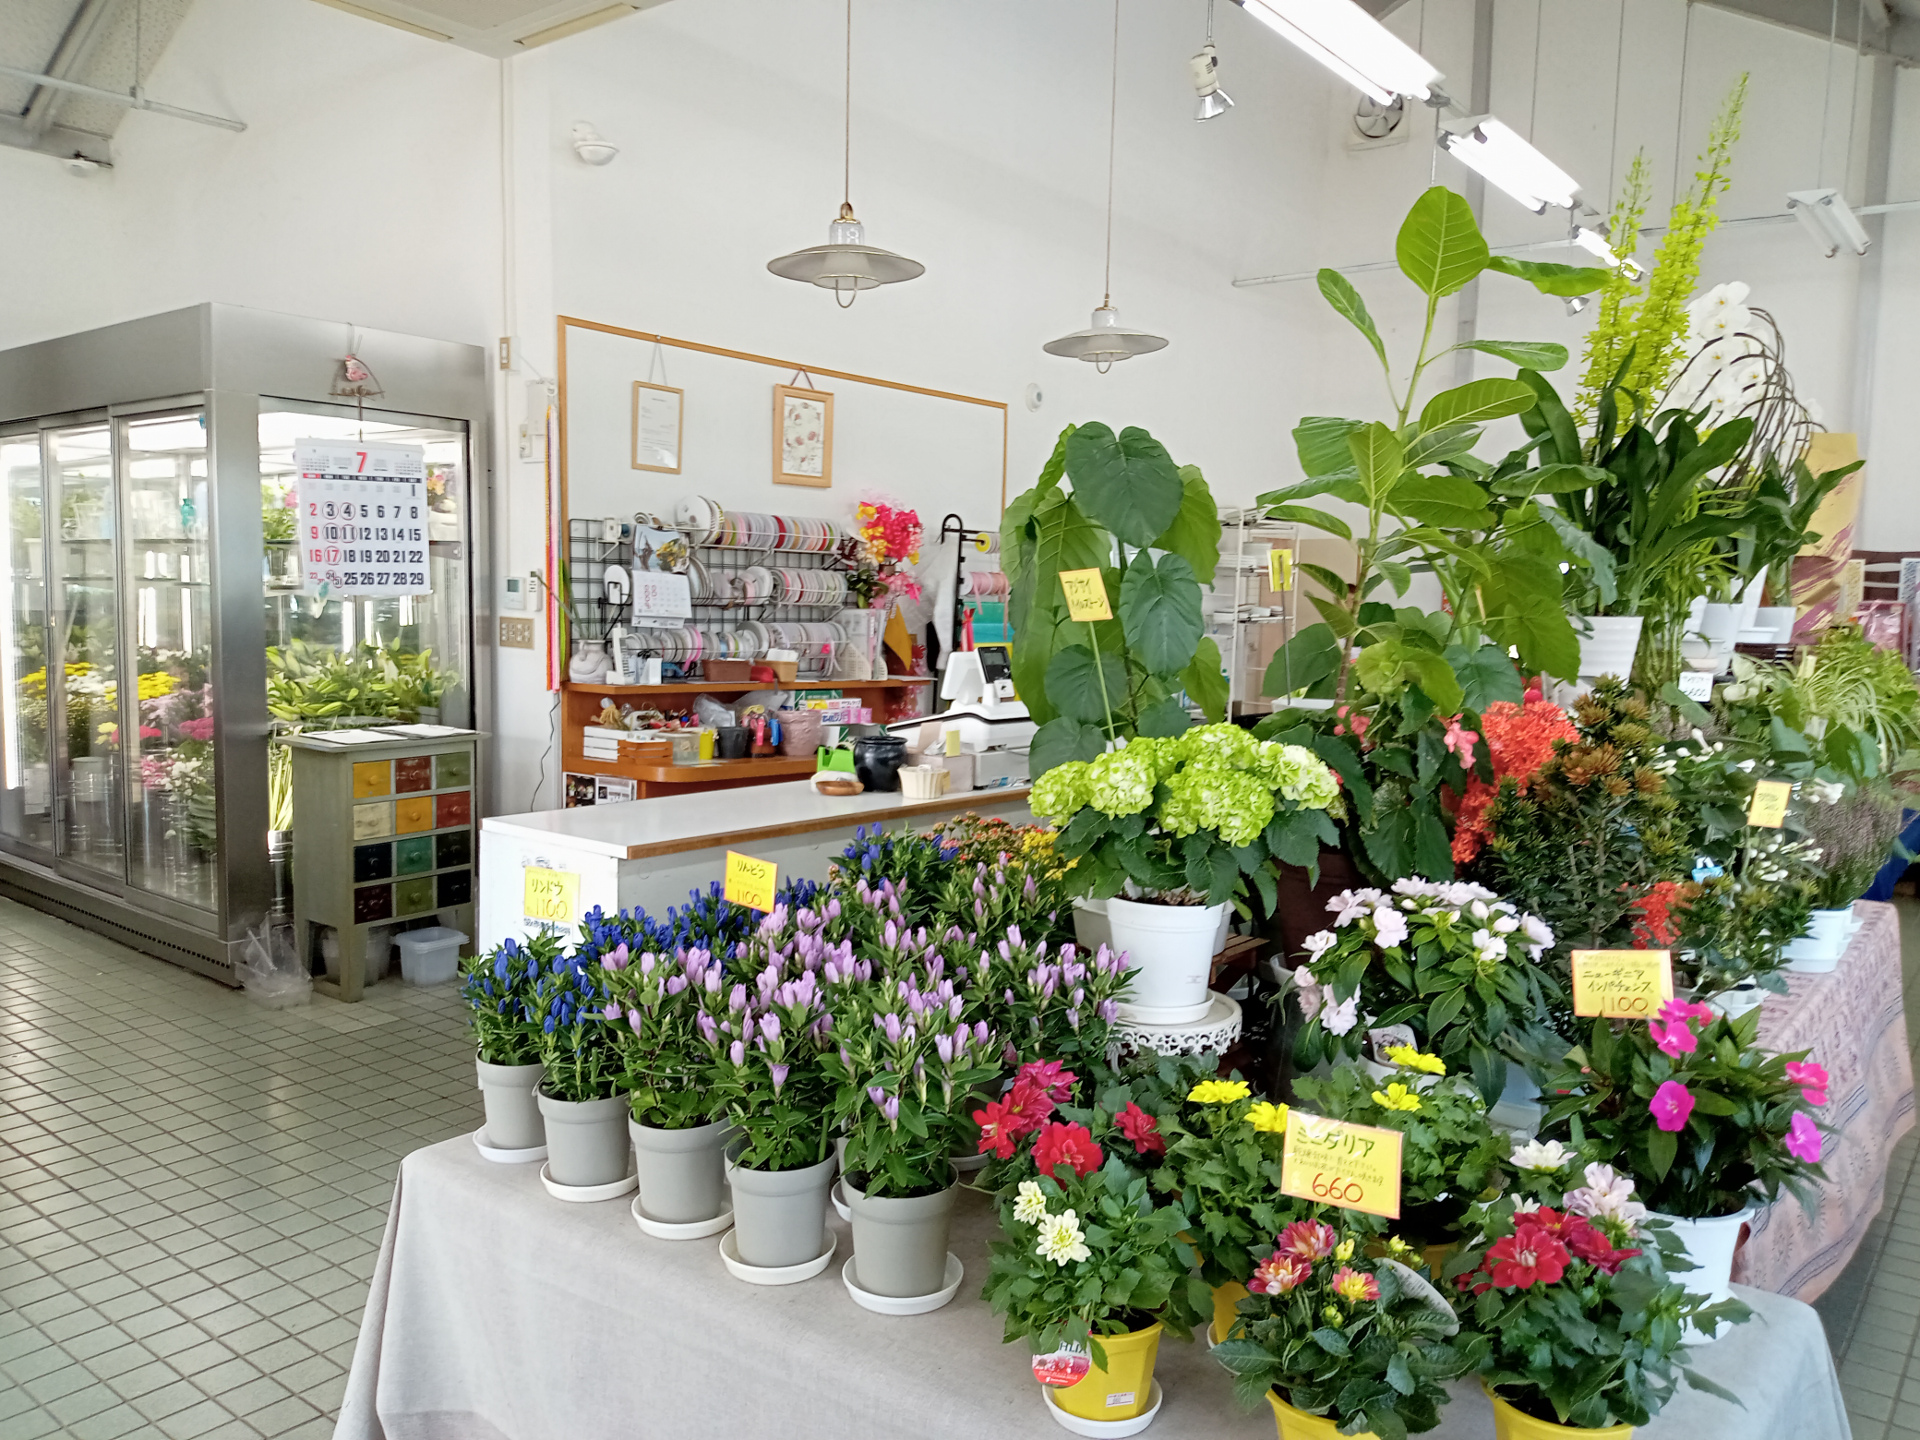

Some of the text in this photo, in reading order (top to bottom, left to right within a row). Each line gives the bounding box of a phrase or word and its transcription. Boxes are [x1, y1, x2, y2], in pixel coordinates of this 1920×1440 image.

[356, 451, 368, 473] 7
[411, 484, 416, 497] 1
[310, 503, 419, 519] 2 3 4 5 6 7 8
[311, 526, 421, 541] 9 10 11 12 13 14 15
[310, 549, 423, 563] 16 17 18 19 20 21 22
[344, 573, 358, 585] 25
[360, 573, 375, 585] 26
[377, 573, 390, 585] 27
[393, 573, 407, 585] 28
[410, 573, 424, 585] 29
[737, 889, 762, 906] 1100
[536, 898, 568, 919] 1100
[1602, 996, 1648, 1012] 1100
[1312, 1172, 1364, 1203] 660
